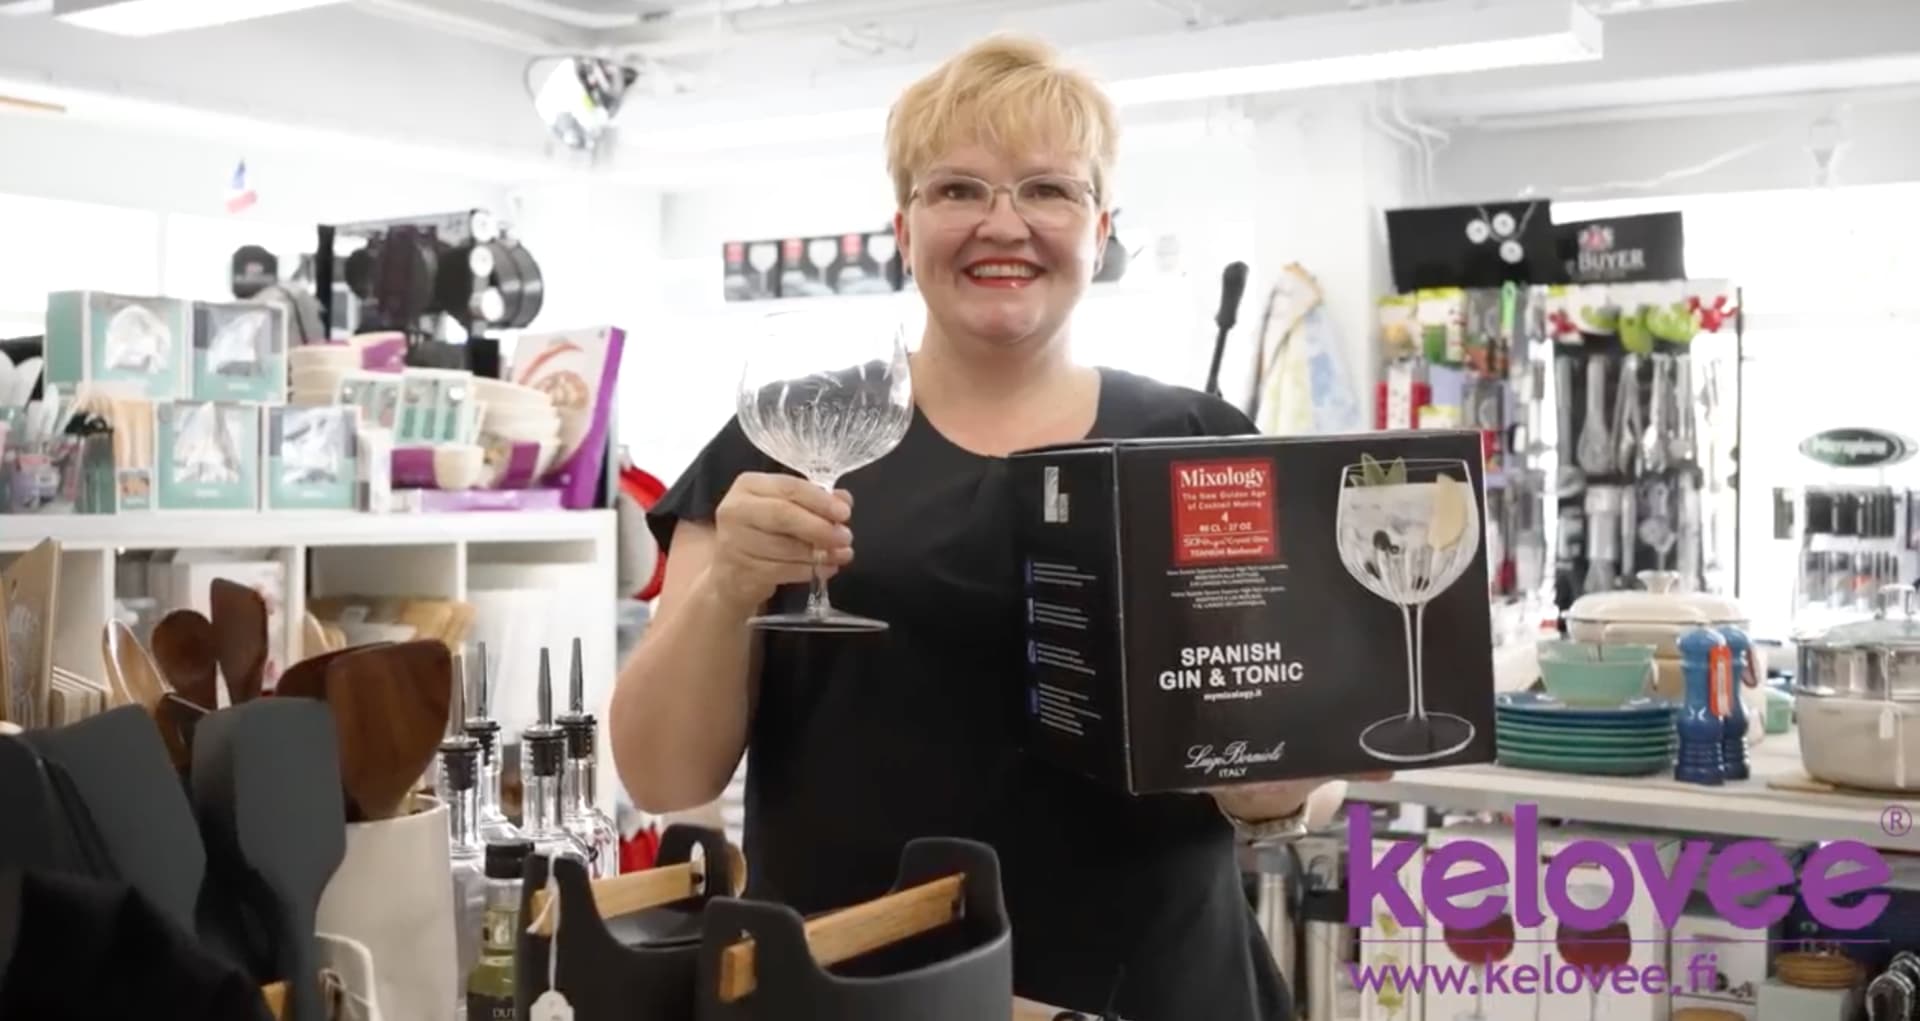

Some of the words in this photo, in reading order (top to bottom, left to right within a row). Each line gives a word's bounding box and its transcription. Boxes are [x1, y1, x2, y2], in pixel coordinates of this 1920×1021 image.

[1579, 249, 1646, 273] BUYER
[1180, 466, 1266, 489] Mixology
[1182, 492, 1197, 501] The
[1250, 489, 1267, 499] Age
[1187, 502, 1197, 511] of
[1198, 501, 1231, 510] Cocktail
[1221, 511, 1229, 523] 4
[1180, 641, 1282, 667] SPANISH
[1159, 669, 1202, 690] GIN
[1208, 667, 1226, 687] &
[1230, 661, 1304, 686] TONIC
[1203, 689, 1262, 702] mymixology.it
[1184, 744, 1226, 775] Luigi
[1222, 740, 1286, 765] Bormioli
[1218, 767, 1248, 778] ITALY
